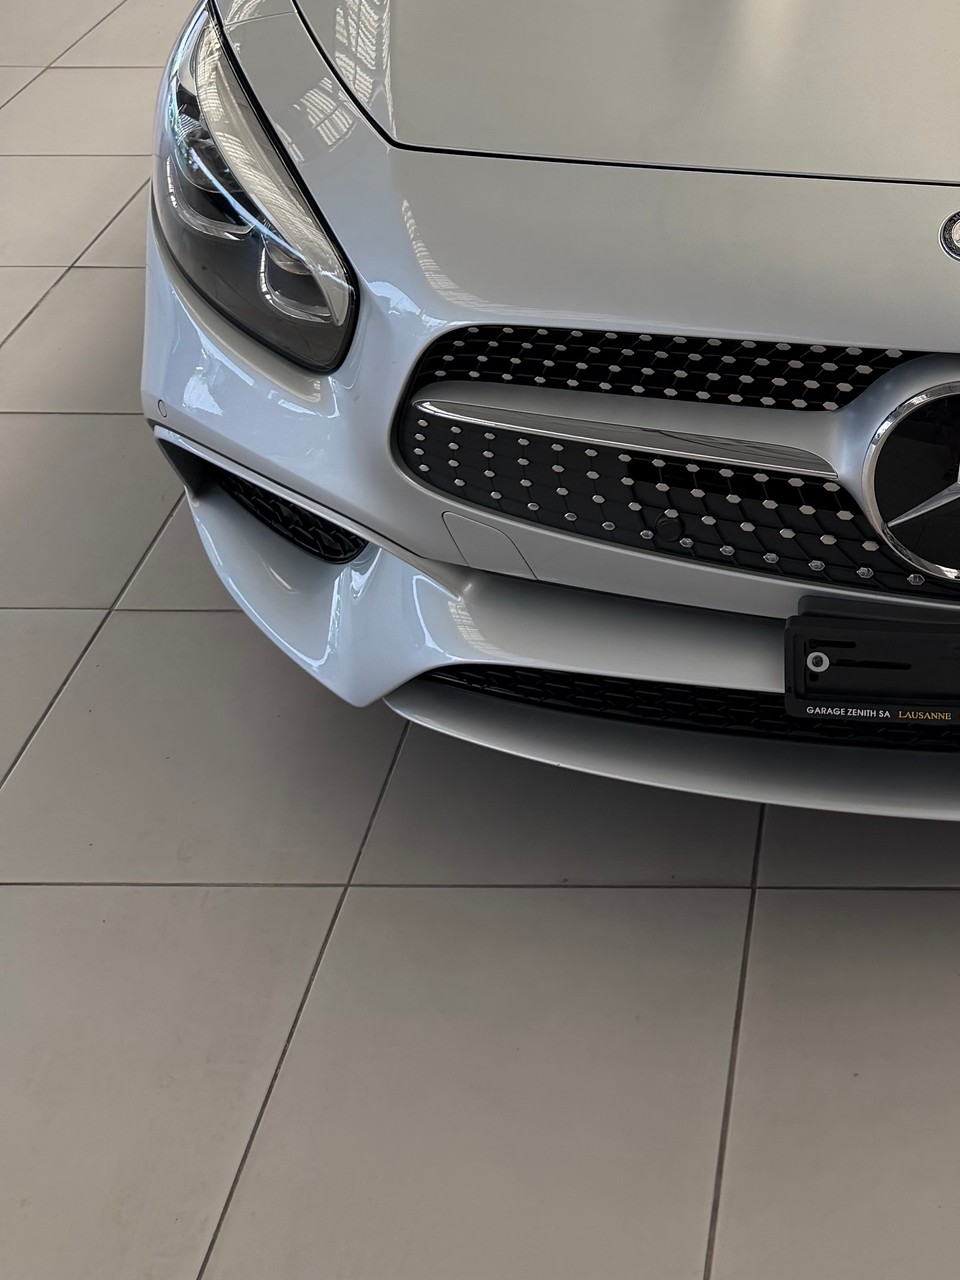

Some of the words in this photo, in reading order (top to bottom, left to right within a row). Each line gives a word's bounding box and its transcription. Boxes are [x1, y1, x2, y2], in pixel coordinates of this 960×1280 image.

[806, 706, 846, 716] GARAGE
[846, 708, 877, 718] ZENITH
[878, 710, 891, 718] SA
[898, 711, 952, 720] LAUSANNE
